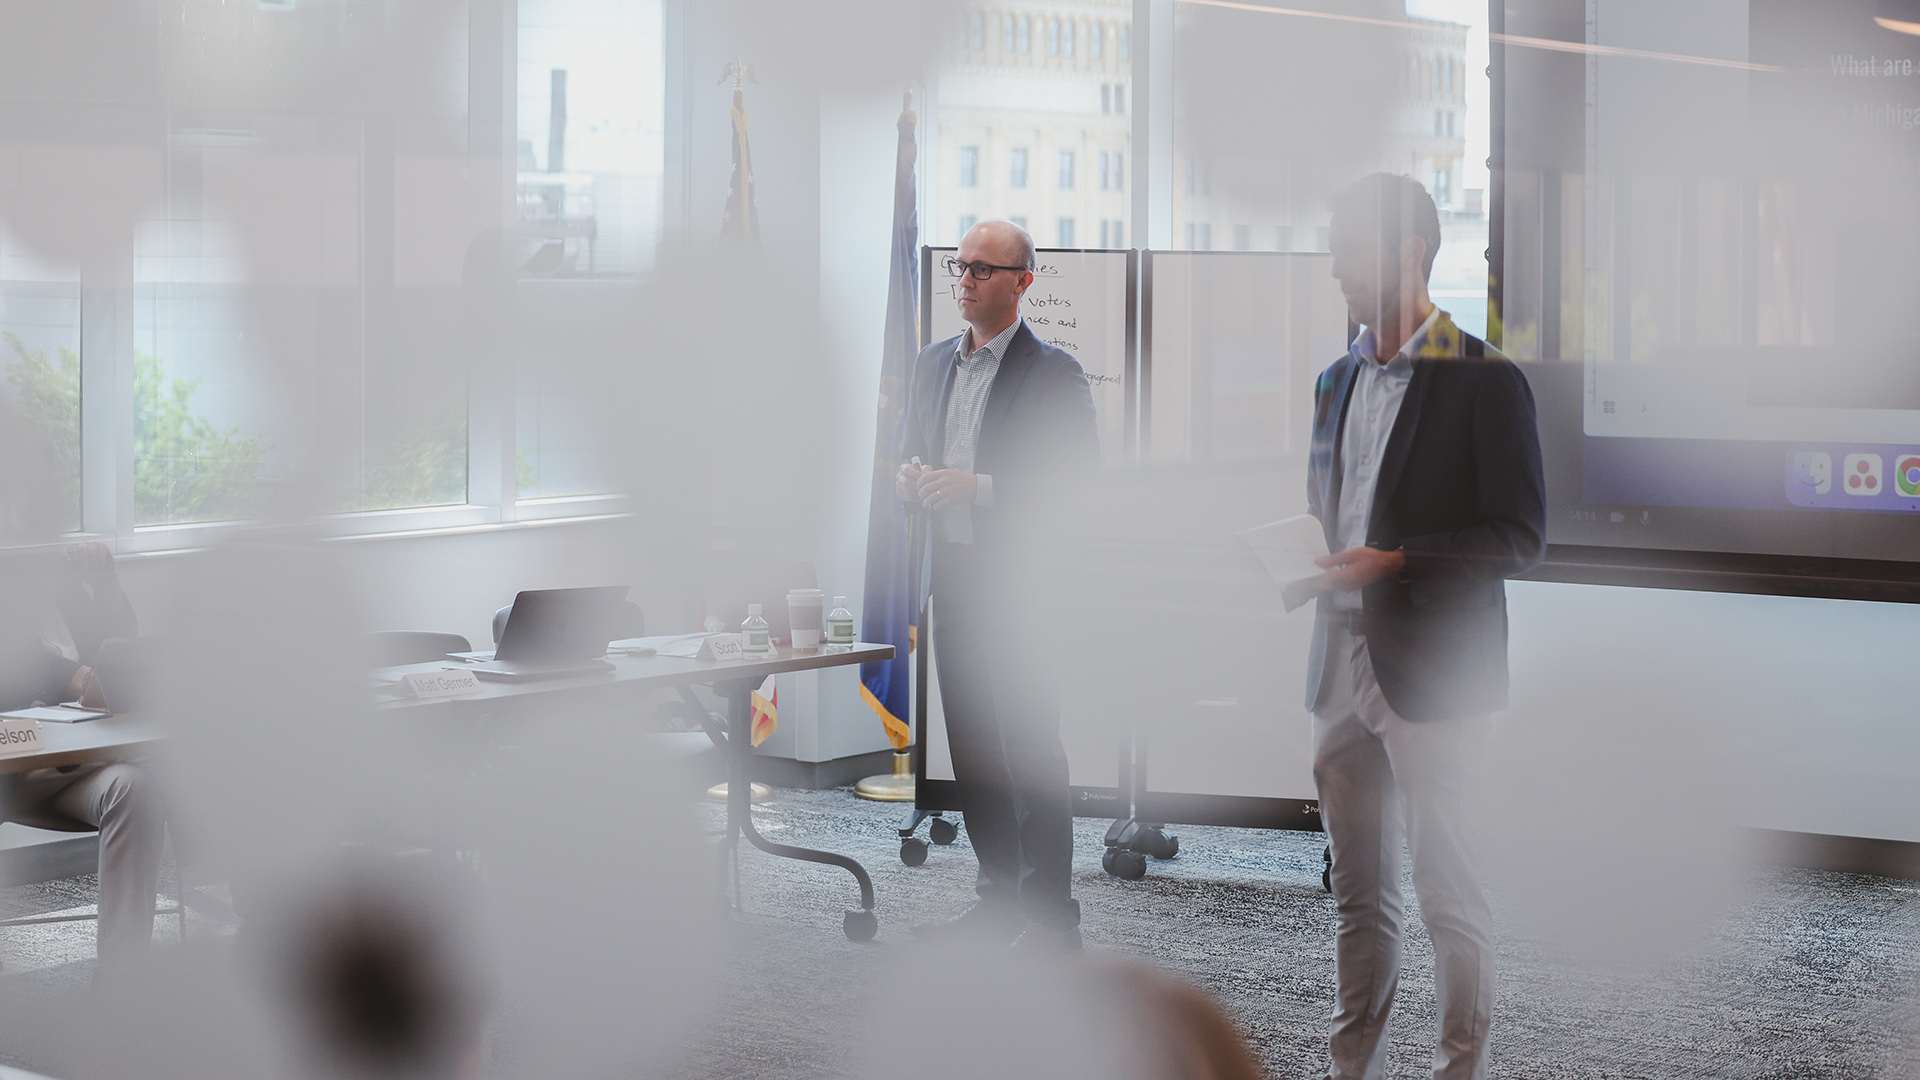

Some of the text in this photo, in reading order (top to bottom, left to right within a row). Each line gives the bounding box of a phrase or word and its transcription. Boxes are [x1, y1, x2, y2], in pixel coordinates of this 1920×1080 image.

[1830, 54, 1912, 77] What are
[1035, 263, 1059, 275] ies
[1026, 315, 1077, 329] nces and
[1044, 337, 1079, 351] ations
[1085, 371, 1121, 387] ngagement
[714, 640, 741, 655] Scott
[414, 678, 439, 693] Matt
[0, 728, 37, 745] elson
[1088, 792, 1117, 801] PolyVision
